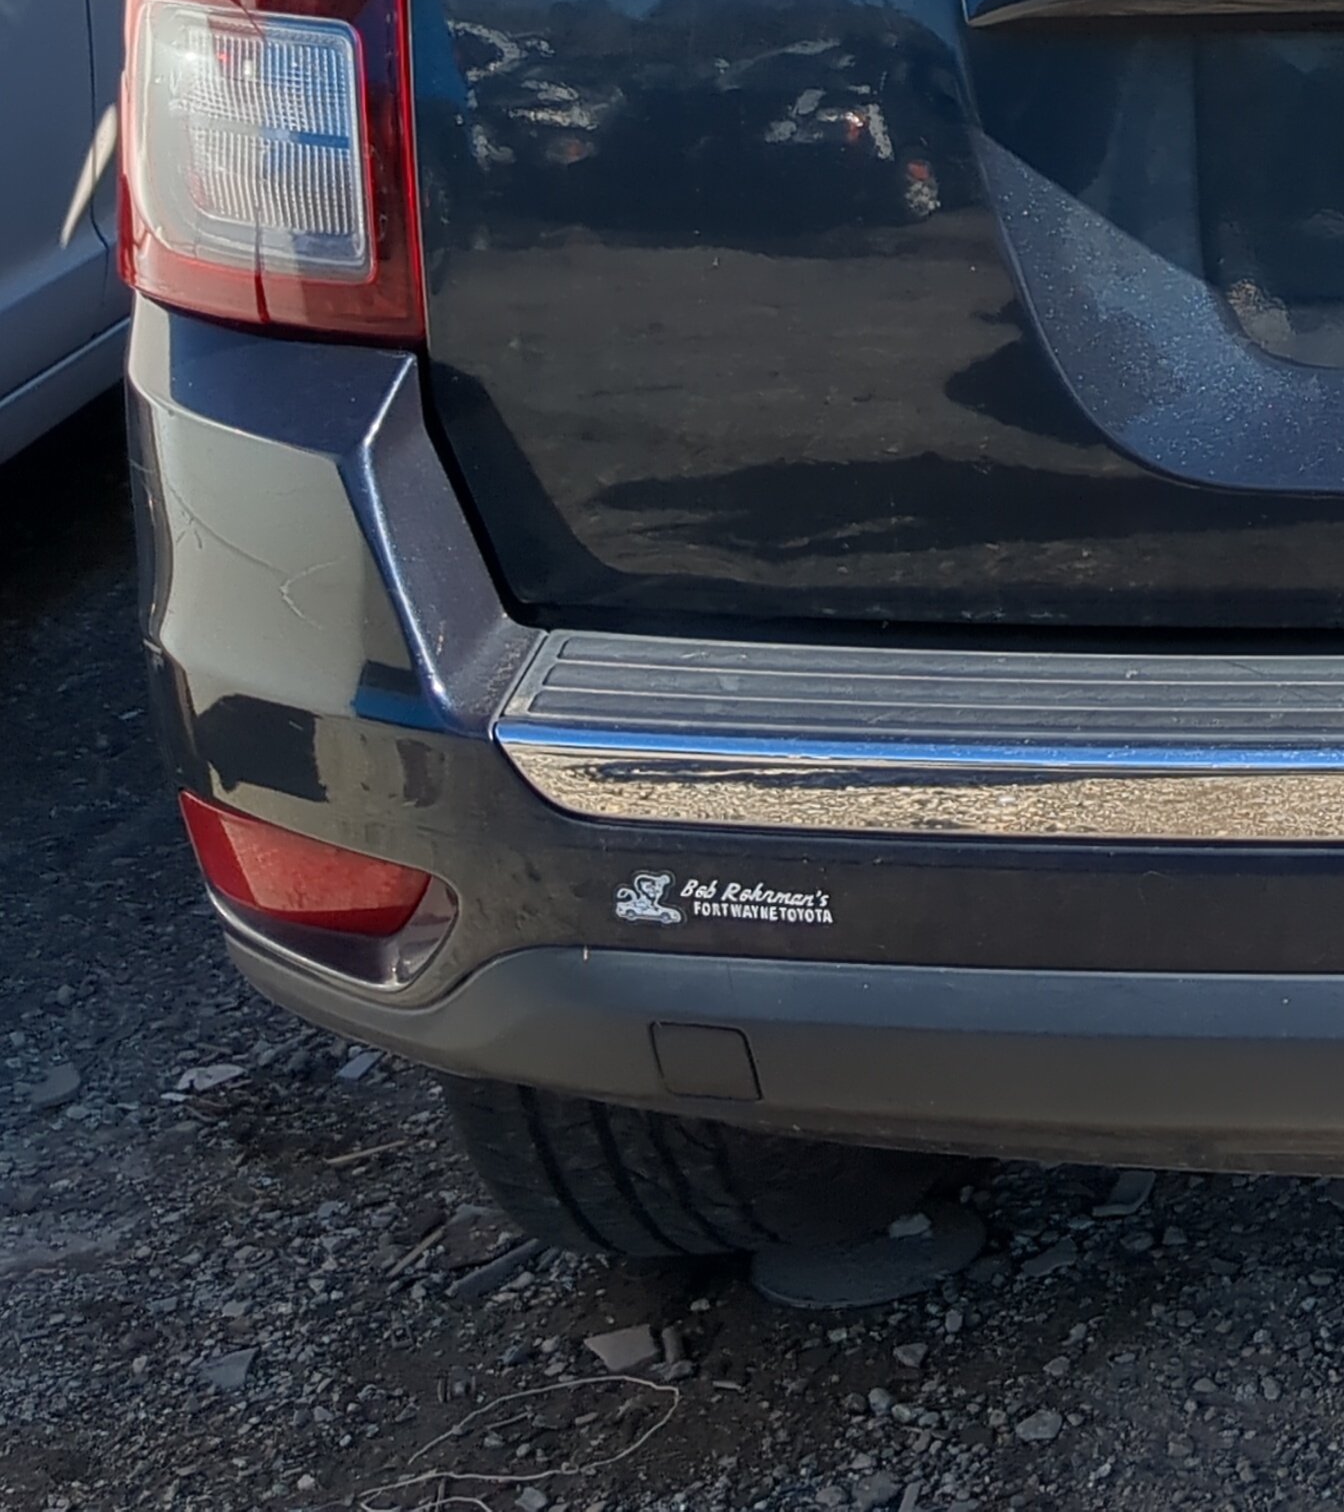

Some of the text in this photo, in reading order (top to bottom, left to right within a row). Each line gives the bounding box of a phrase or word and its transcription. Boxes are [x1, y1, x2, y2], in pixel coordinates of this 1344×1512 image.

[680, 879, 830, 907] Bob Rohrman's
[693, 901, 834, 923] FORT WAYNE TOYOTA
